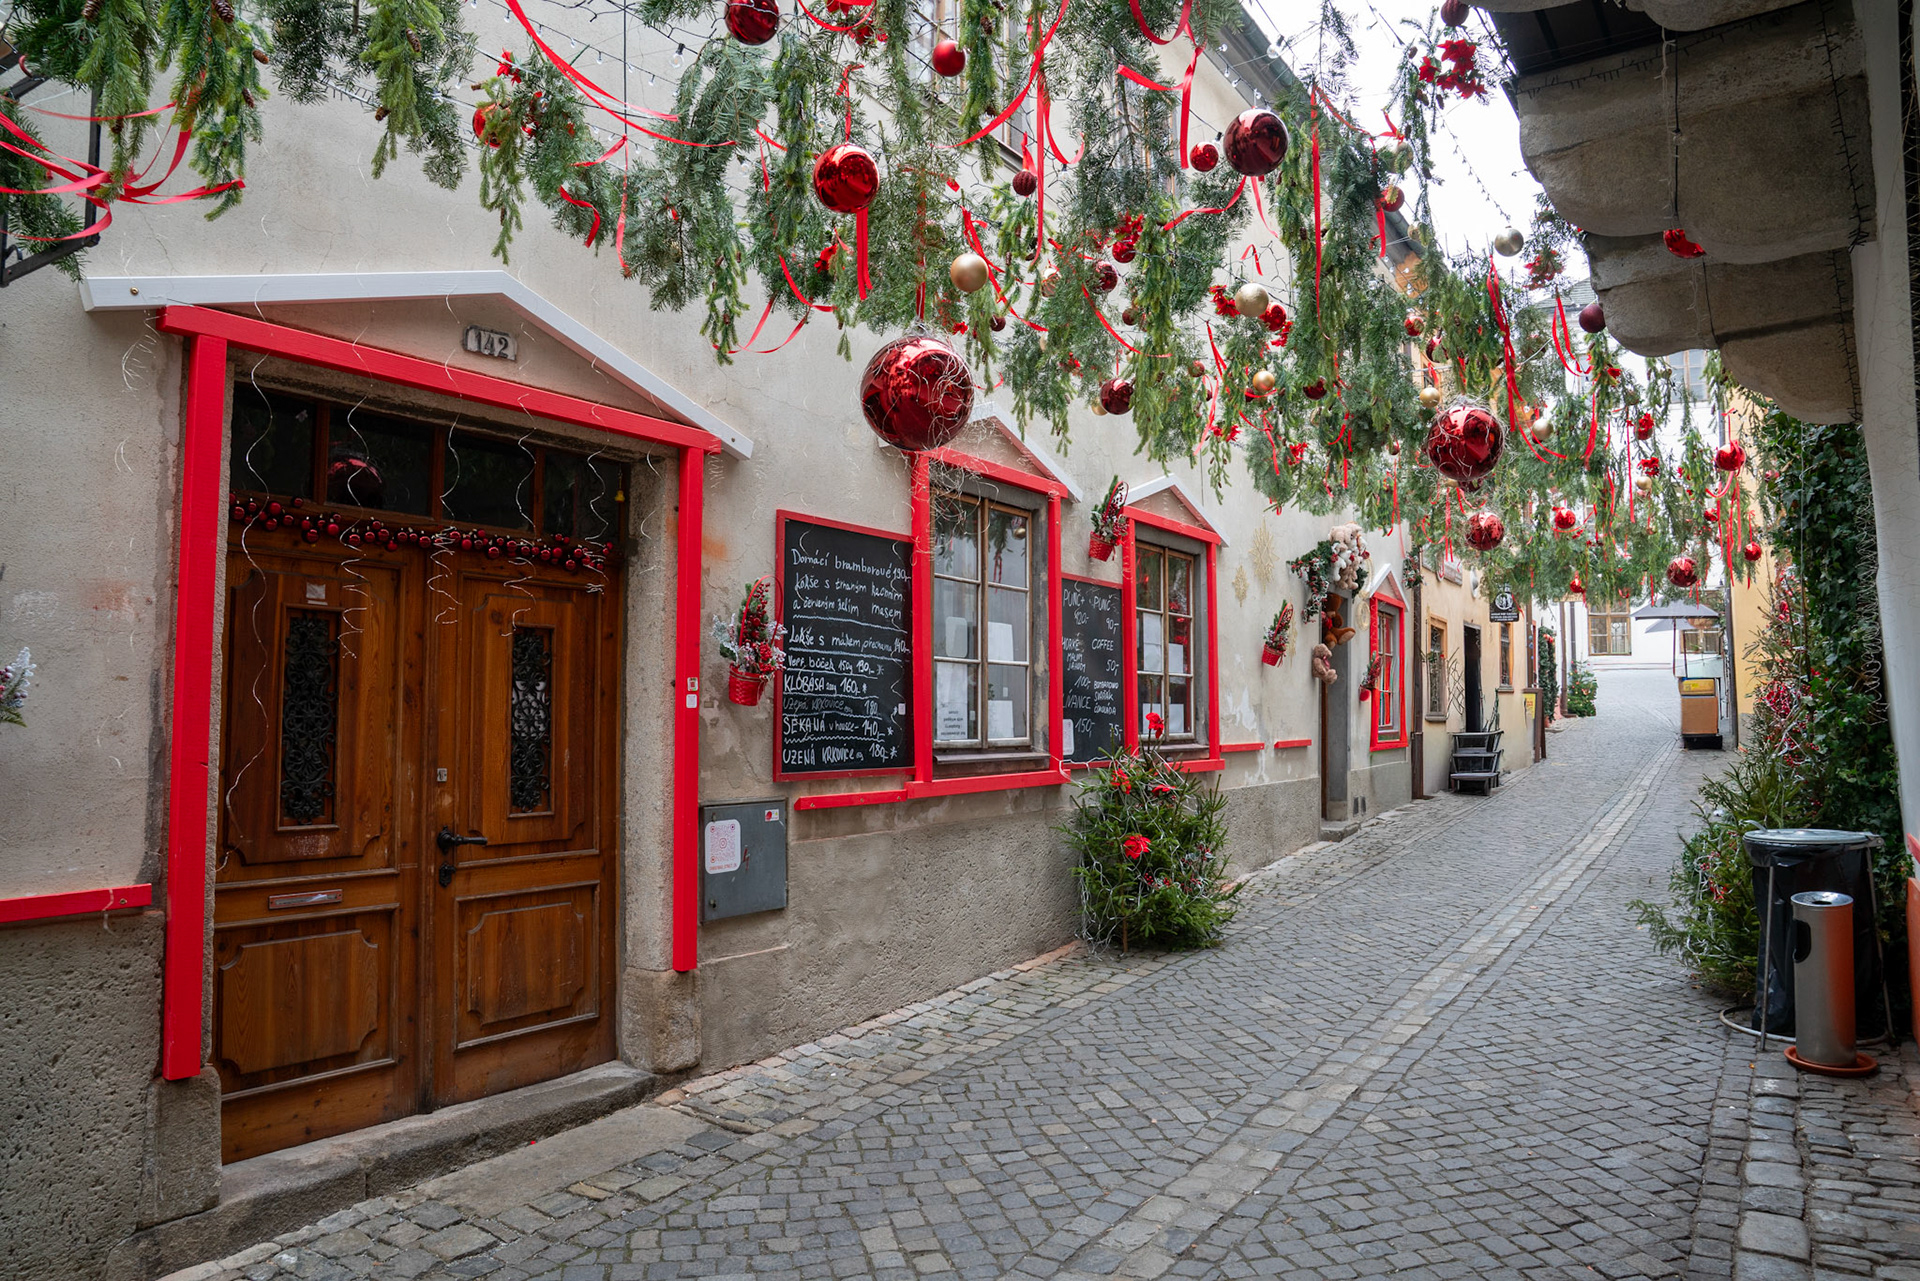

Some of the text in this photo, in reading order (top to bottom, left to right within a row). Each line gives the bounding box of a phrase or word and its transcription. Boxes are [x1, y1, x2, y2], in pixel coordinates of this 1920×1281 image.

[475, 331, 509, 359] 142
[791, 548, 830, 566] Domácí
[834, 556, 892, 579] bramborové
[824, 579, 831, 589] s
[793, 600, 801, 610] a
[818, 635, 825, 646] s
[1091, 638, 1114, 651] COFFEE
[783, 673, 825, 693] KLOBÁSA
[783, 713, 826, 735] SEKANÁ
[782, 743, 816, 766] UZENÁ
